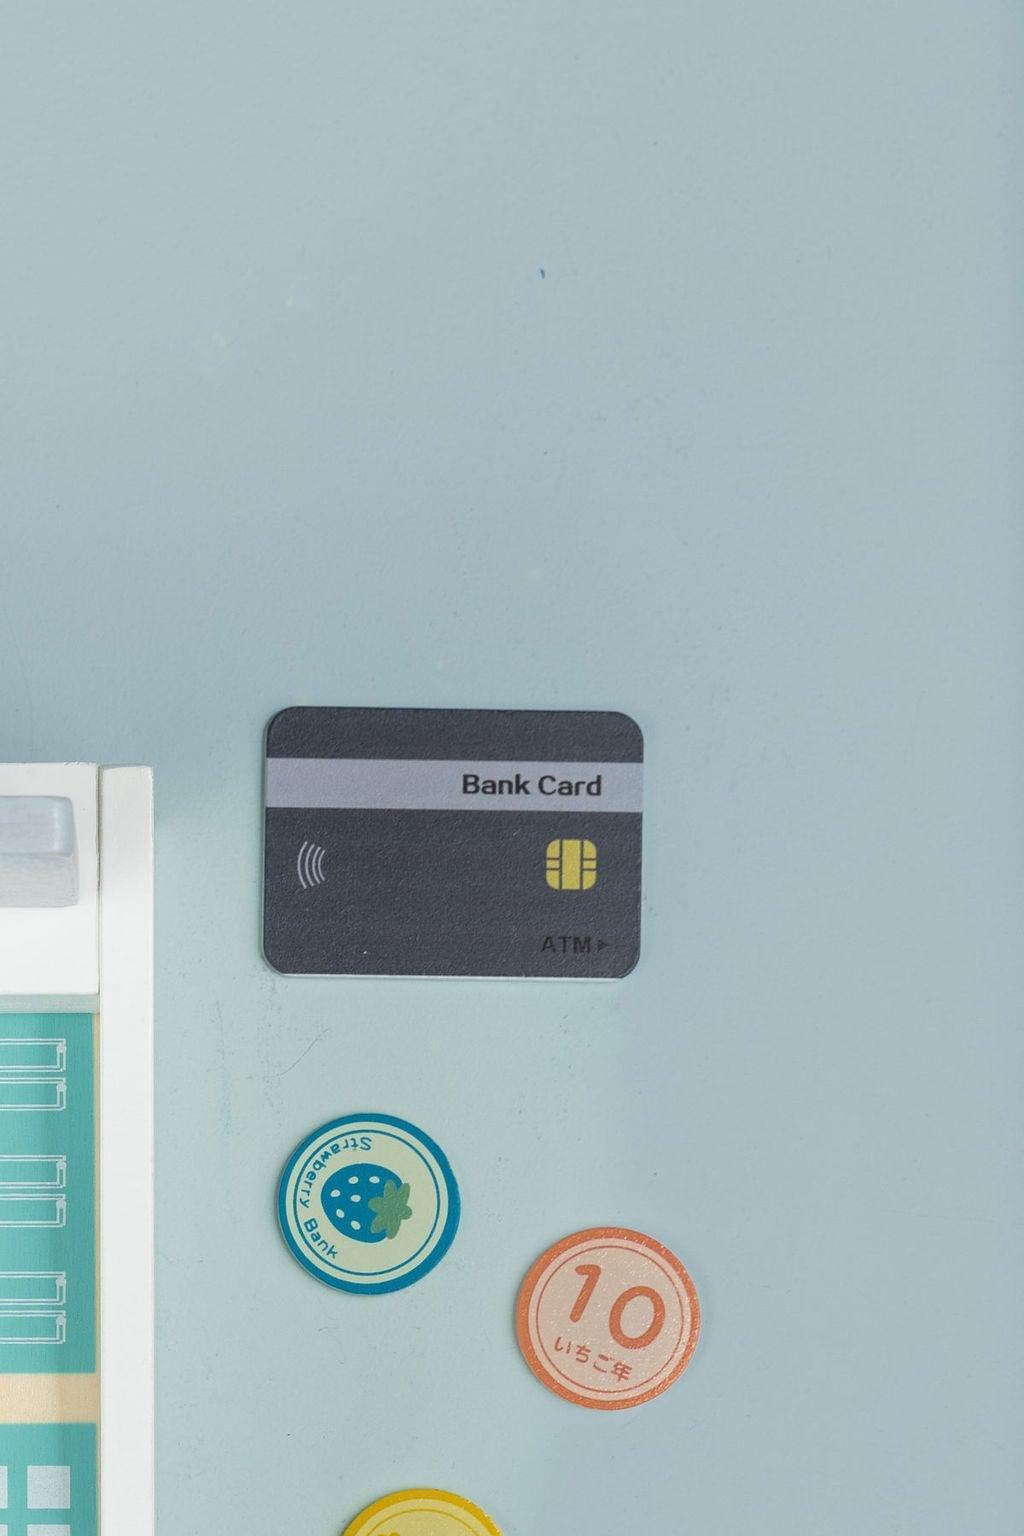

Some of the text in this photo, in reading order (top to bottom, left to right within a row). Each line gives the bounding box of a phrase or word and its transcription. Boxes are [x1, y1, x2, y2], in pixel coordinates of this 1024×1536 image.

[462, 773, 602, 797] Bank Card
[540, 935, 592, 955] ATM
[300, 1136, 373, 1260] Strawberry Bank
[569, 1264, 666, 1350] 10
[554, 1336, 633, 1382] いちご年
